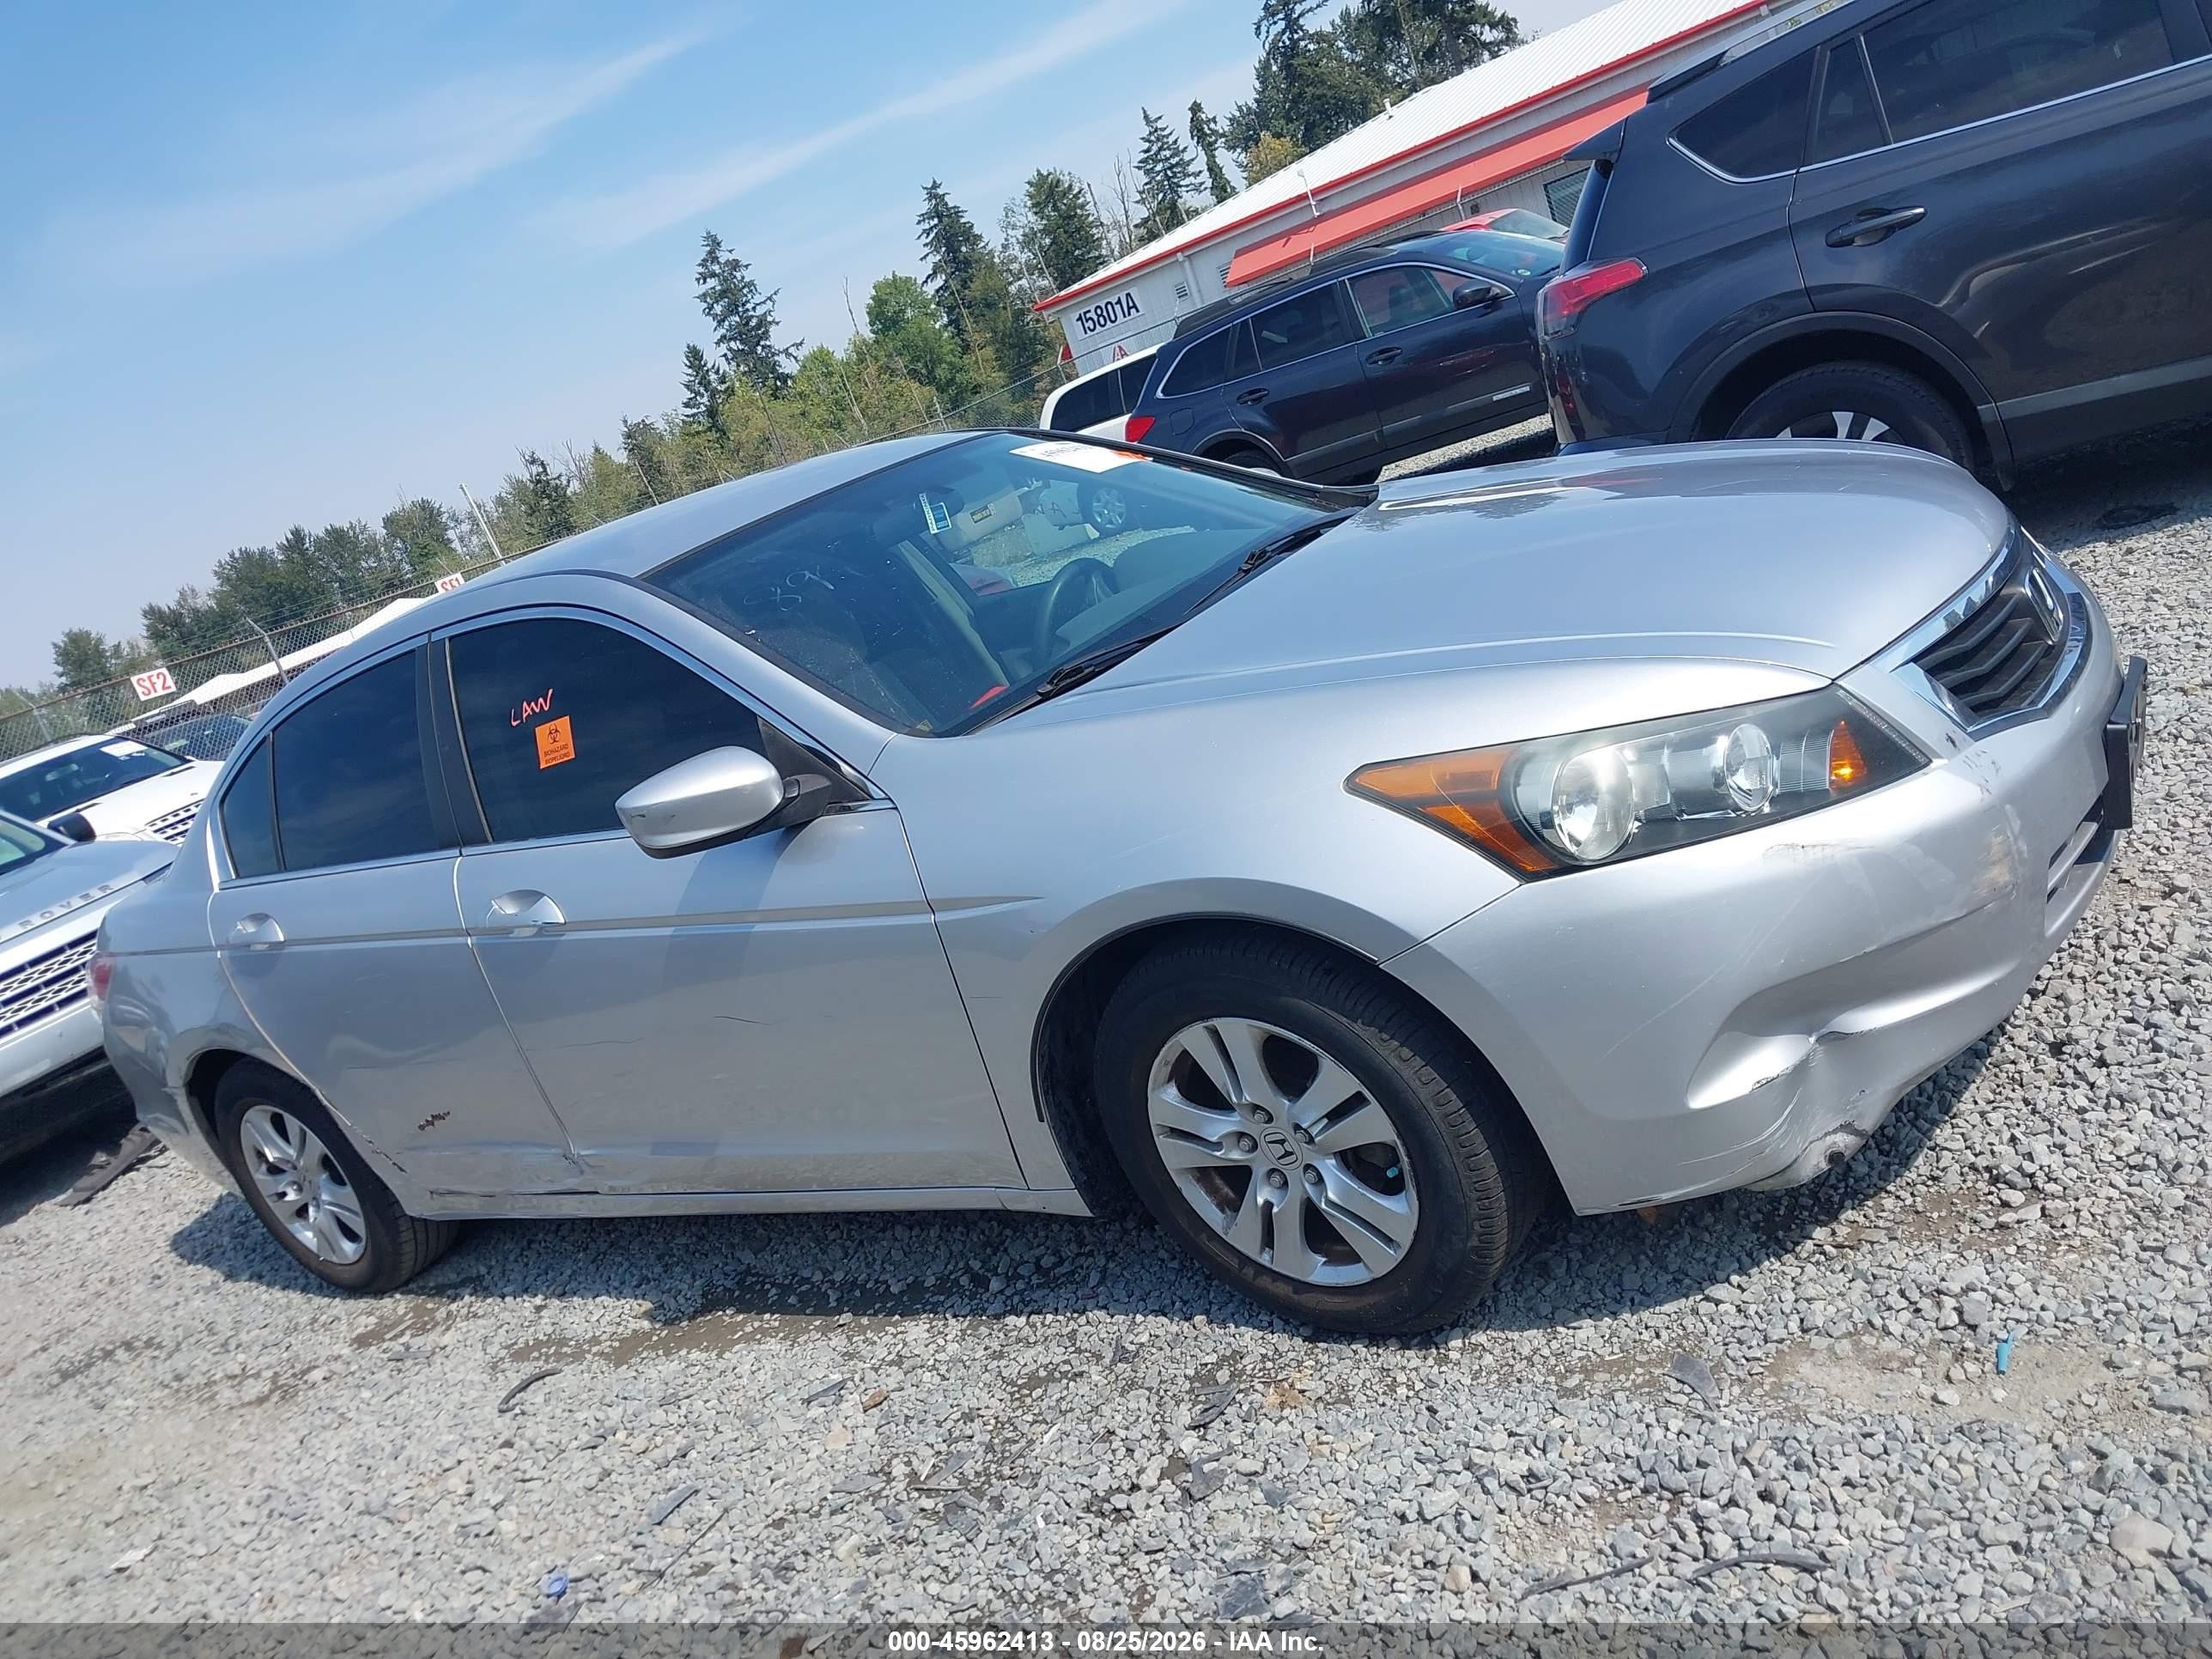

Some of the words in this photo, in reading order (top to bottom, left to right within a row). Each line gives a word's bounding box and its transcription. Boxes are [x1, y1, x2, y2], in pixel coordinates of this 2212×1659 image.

[1075, 292, 1140, 335] 15801A
[137, 672, 172, 696] SF2
[511, 689, 553, 726] LAW
[17, 884, 114, 929] ROVER
